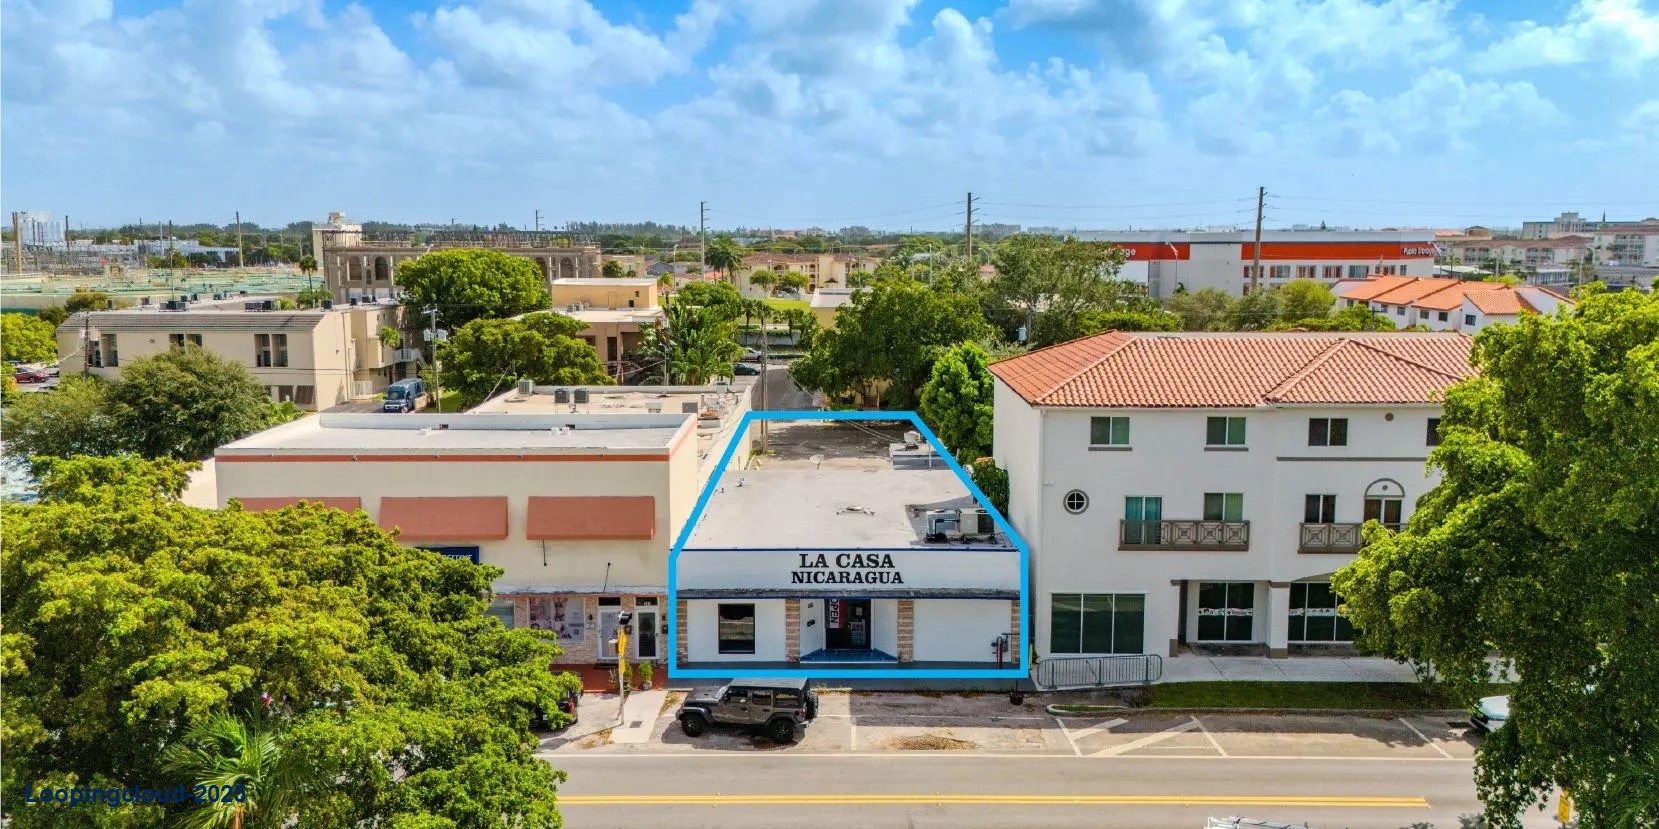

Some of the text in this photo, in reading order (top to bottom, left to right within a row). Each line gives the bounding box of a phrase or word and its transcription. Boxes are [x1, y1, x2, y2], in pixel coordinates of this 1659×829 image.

[799, 553, 895, 568] LA CASA
[791, 571, 904, 584] NICARAGUA
[830, 598, 839, 623] OPEN
